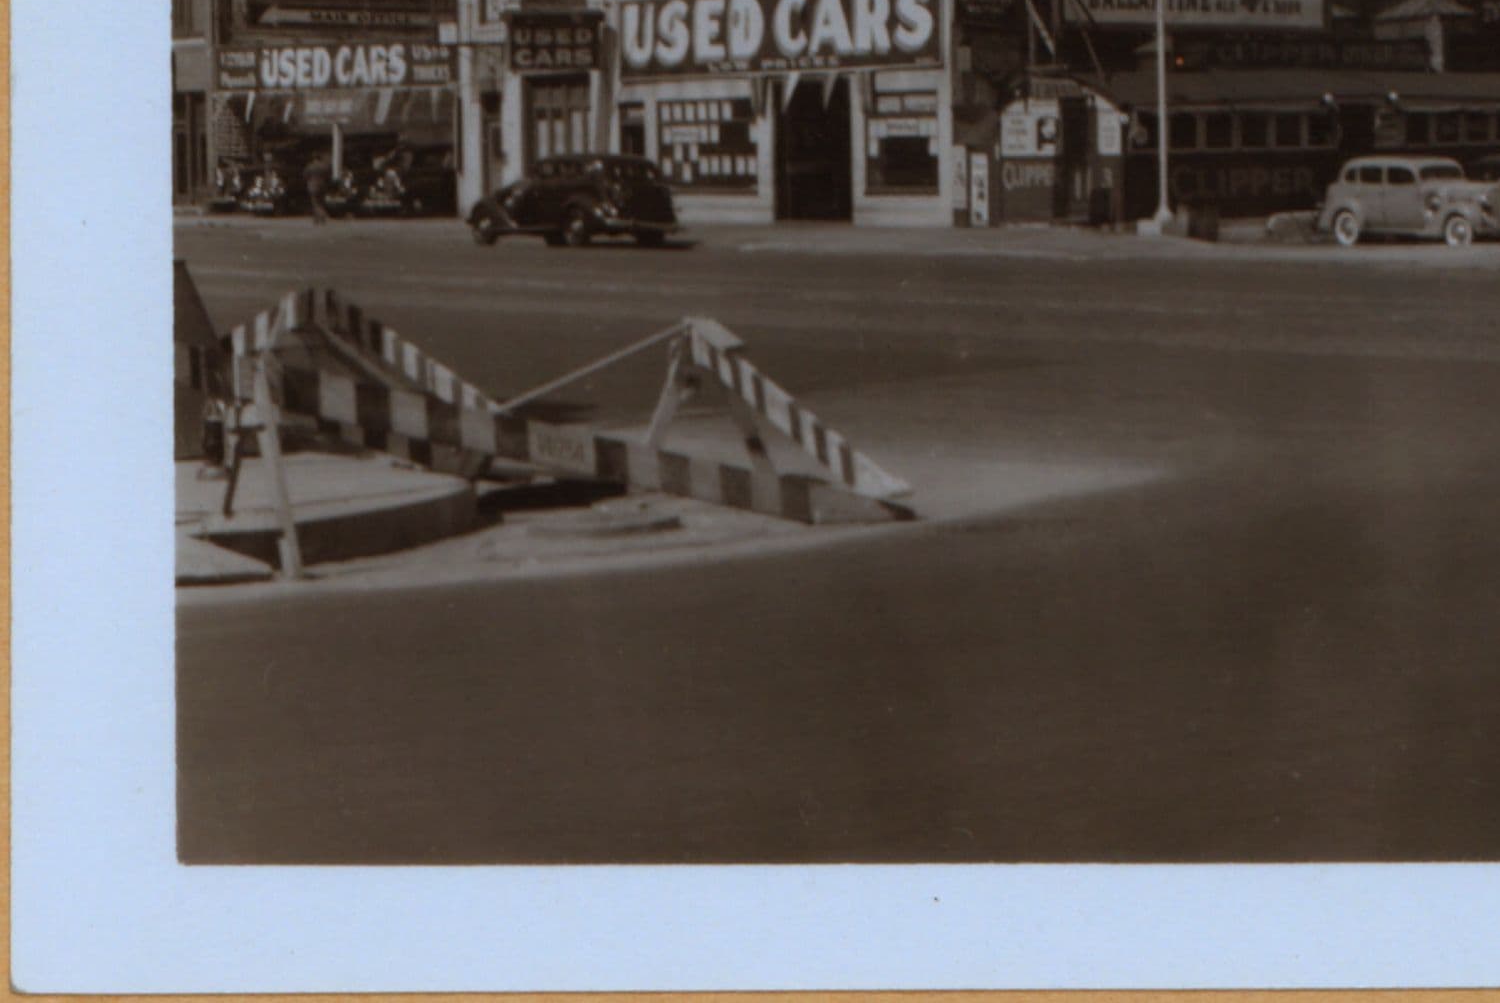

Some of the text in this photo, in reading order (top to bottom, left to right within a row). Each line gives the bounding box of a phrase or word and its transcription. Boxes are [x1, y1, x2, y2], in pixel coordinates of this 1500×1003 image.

[513, 28, 594, 45] USED
[260, 43, 407, 88] USED CARS
[513, 47, 594, 66] CARS
